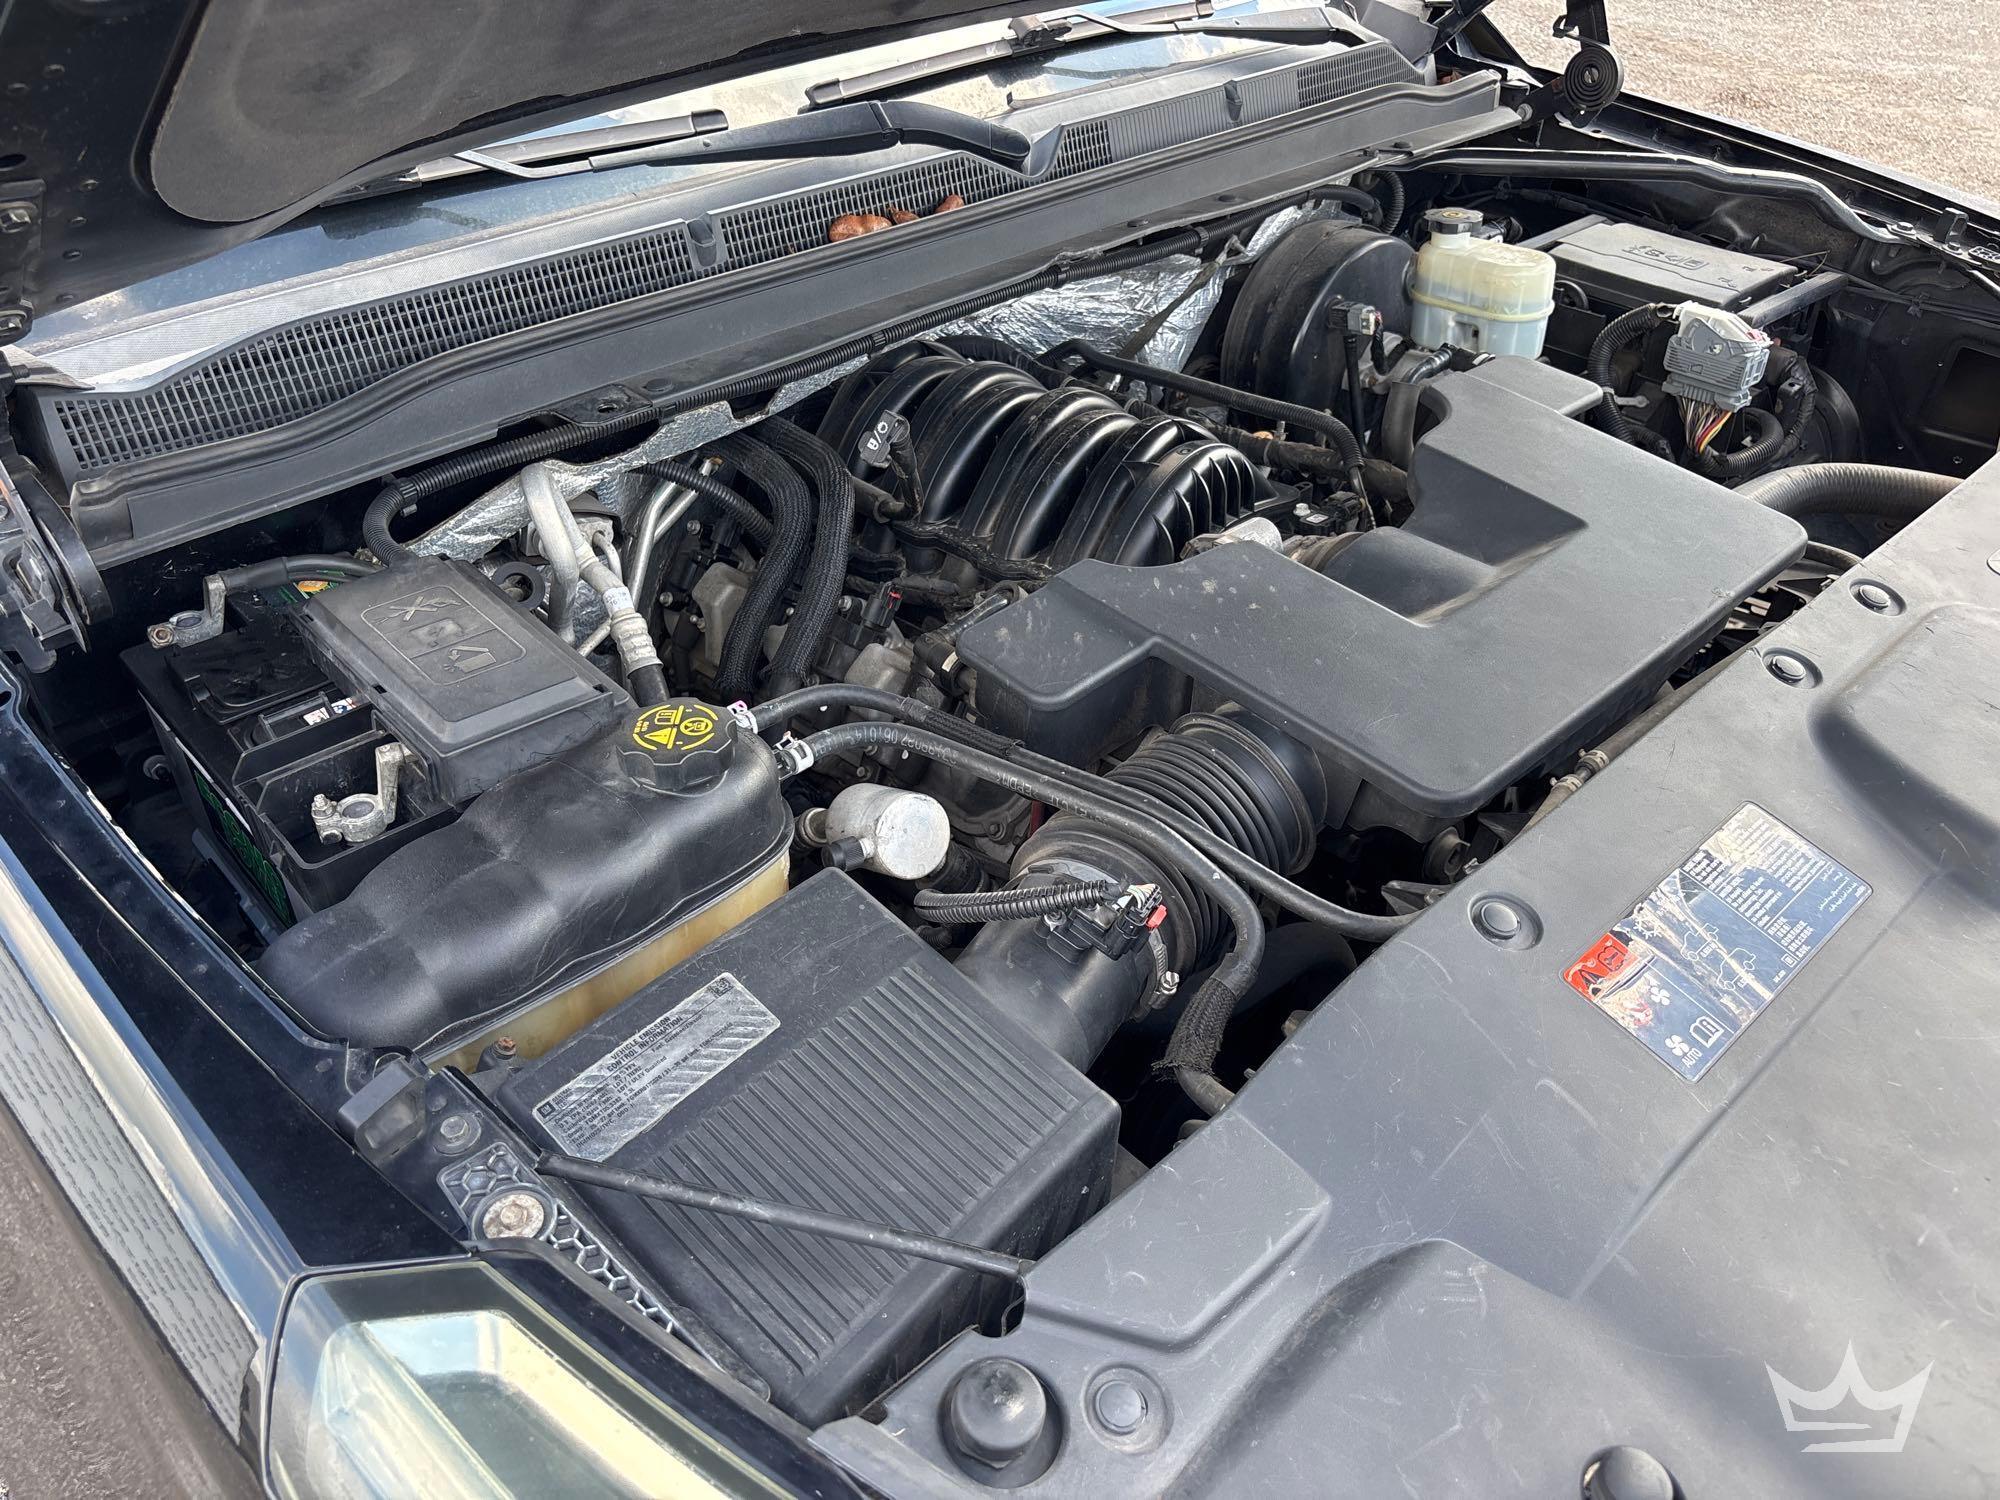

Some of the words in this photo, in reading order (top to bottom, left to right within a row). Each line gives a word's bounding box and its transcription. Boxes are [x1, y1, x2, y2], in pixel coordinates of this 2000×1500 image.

[605, 1047, 638, 1072] CONTROL
[637, 1015, 683, 1050] INFORMATION
[610, 1038, 640, 1060] VEHICLE
[638, 1015, 671, 1040] EMISSION
[1682, 1048, 1703, 1069] AUTO
